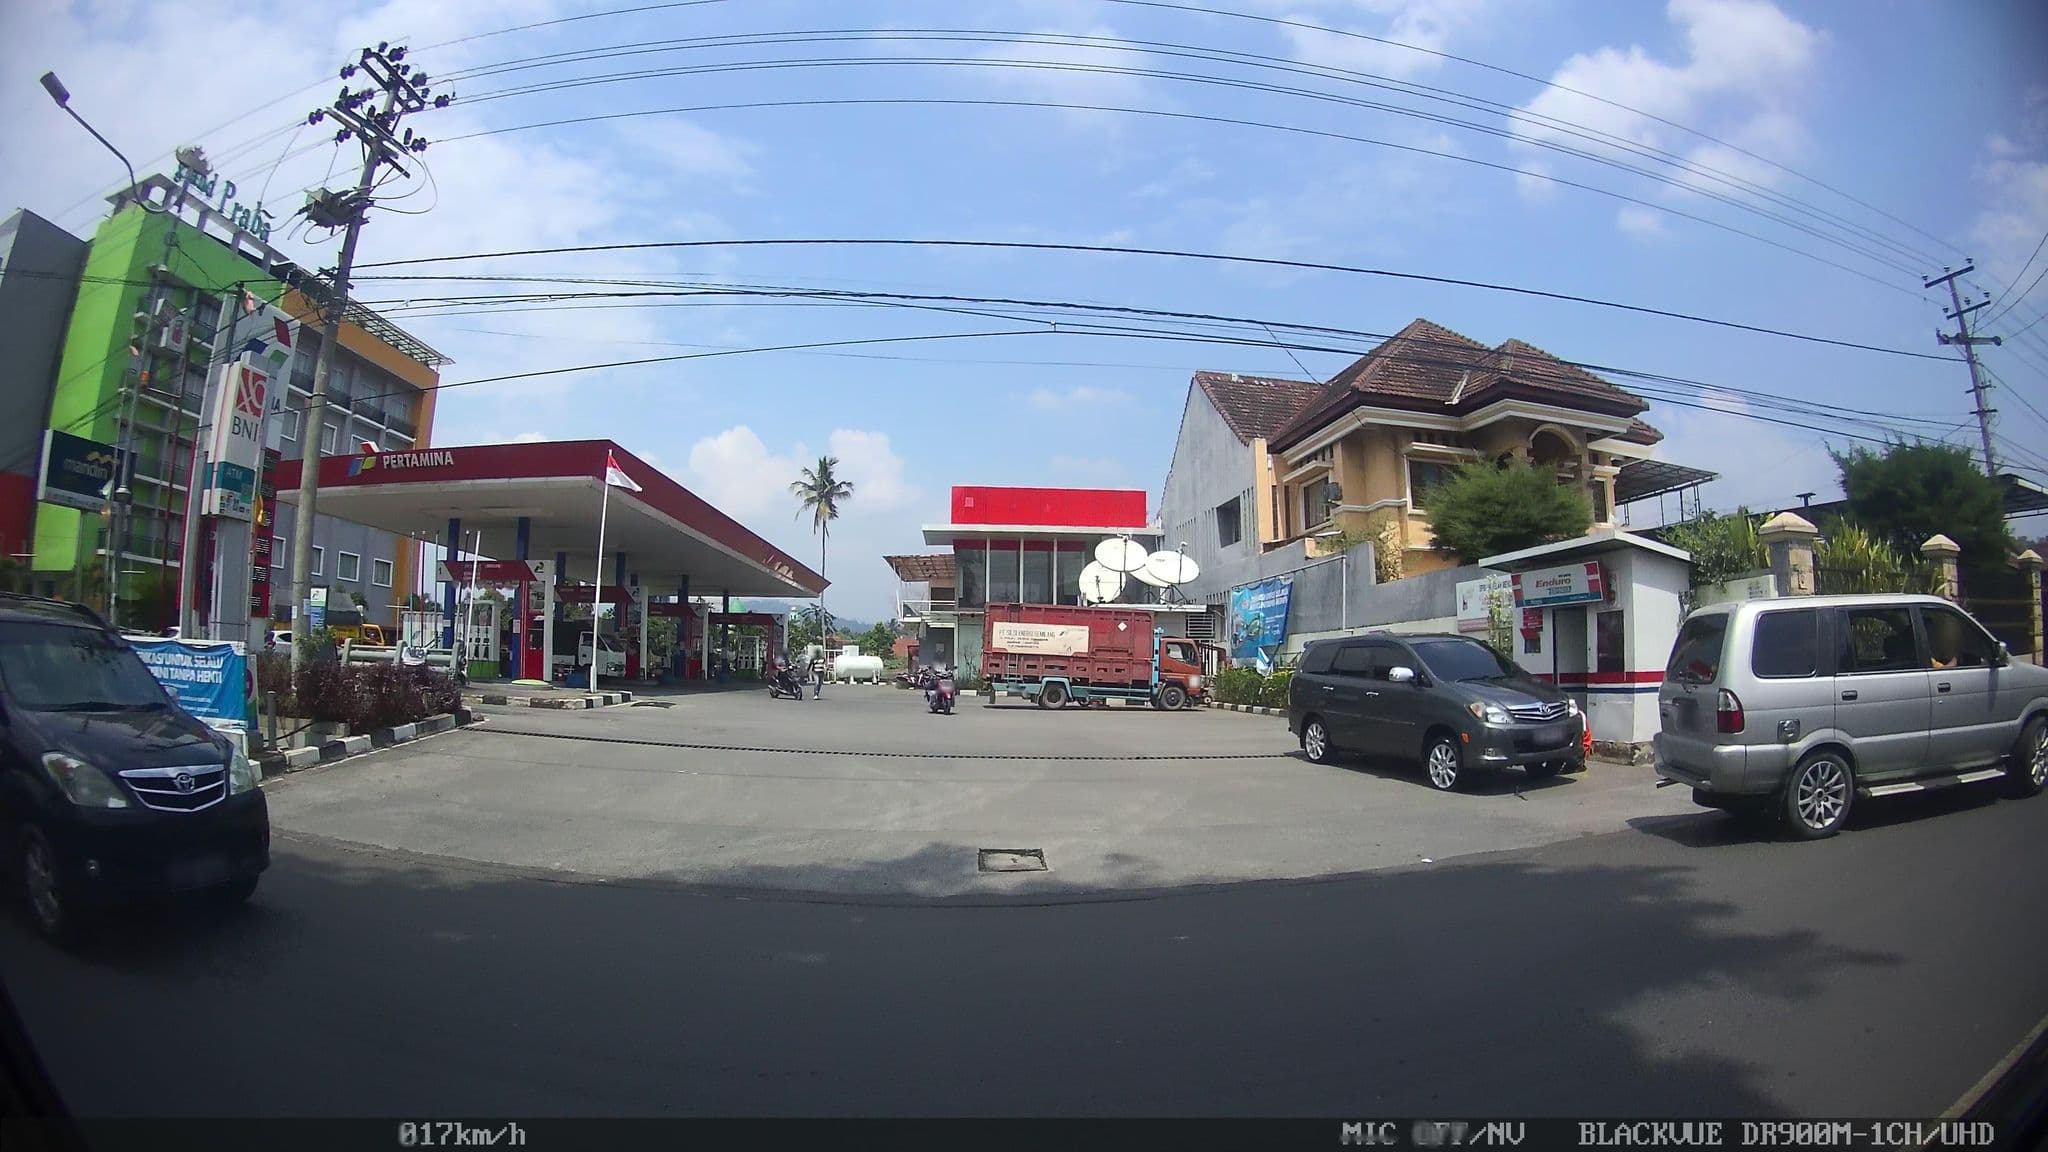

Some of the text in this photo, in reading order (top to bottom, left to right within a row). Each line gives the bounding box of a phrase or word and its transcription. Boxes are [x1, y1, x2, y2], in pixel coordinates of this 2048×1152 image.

[232, 416, 259, 442] BNI
[383, 452, 454, 469] PERTAMINA
[535, 561, 544, 573] 2
[1535, 578, 1571, 588] Enduro
[165, 653, 193, 667] UNTUK
[194, 655, 223, 669] SELALU
[169, 667, 195, 682] TANPA
[197, 670, 222, 684] HENTI
